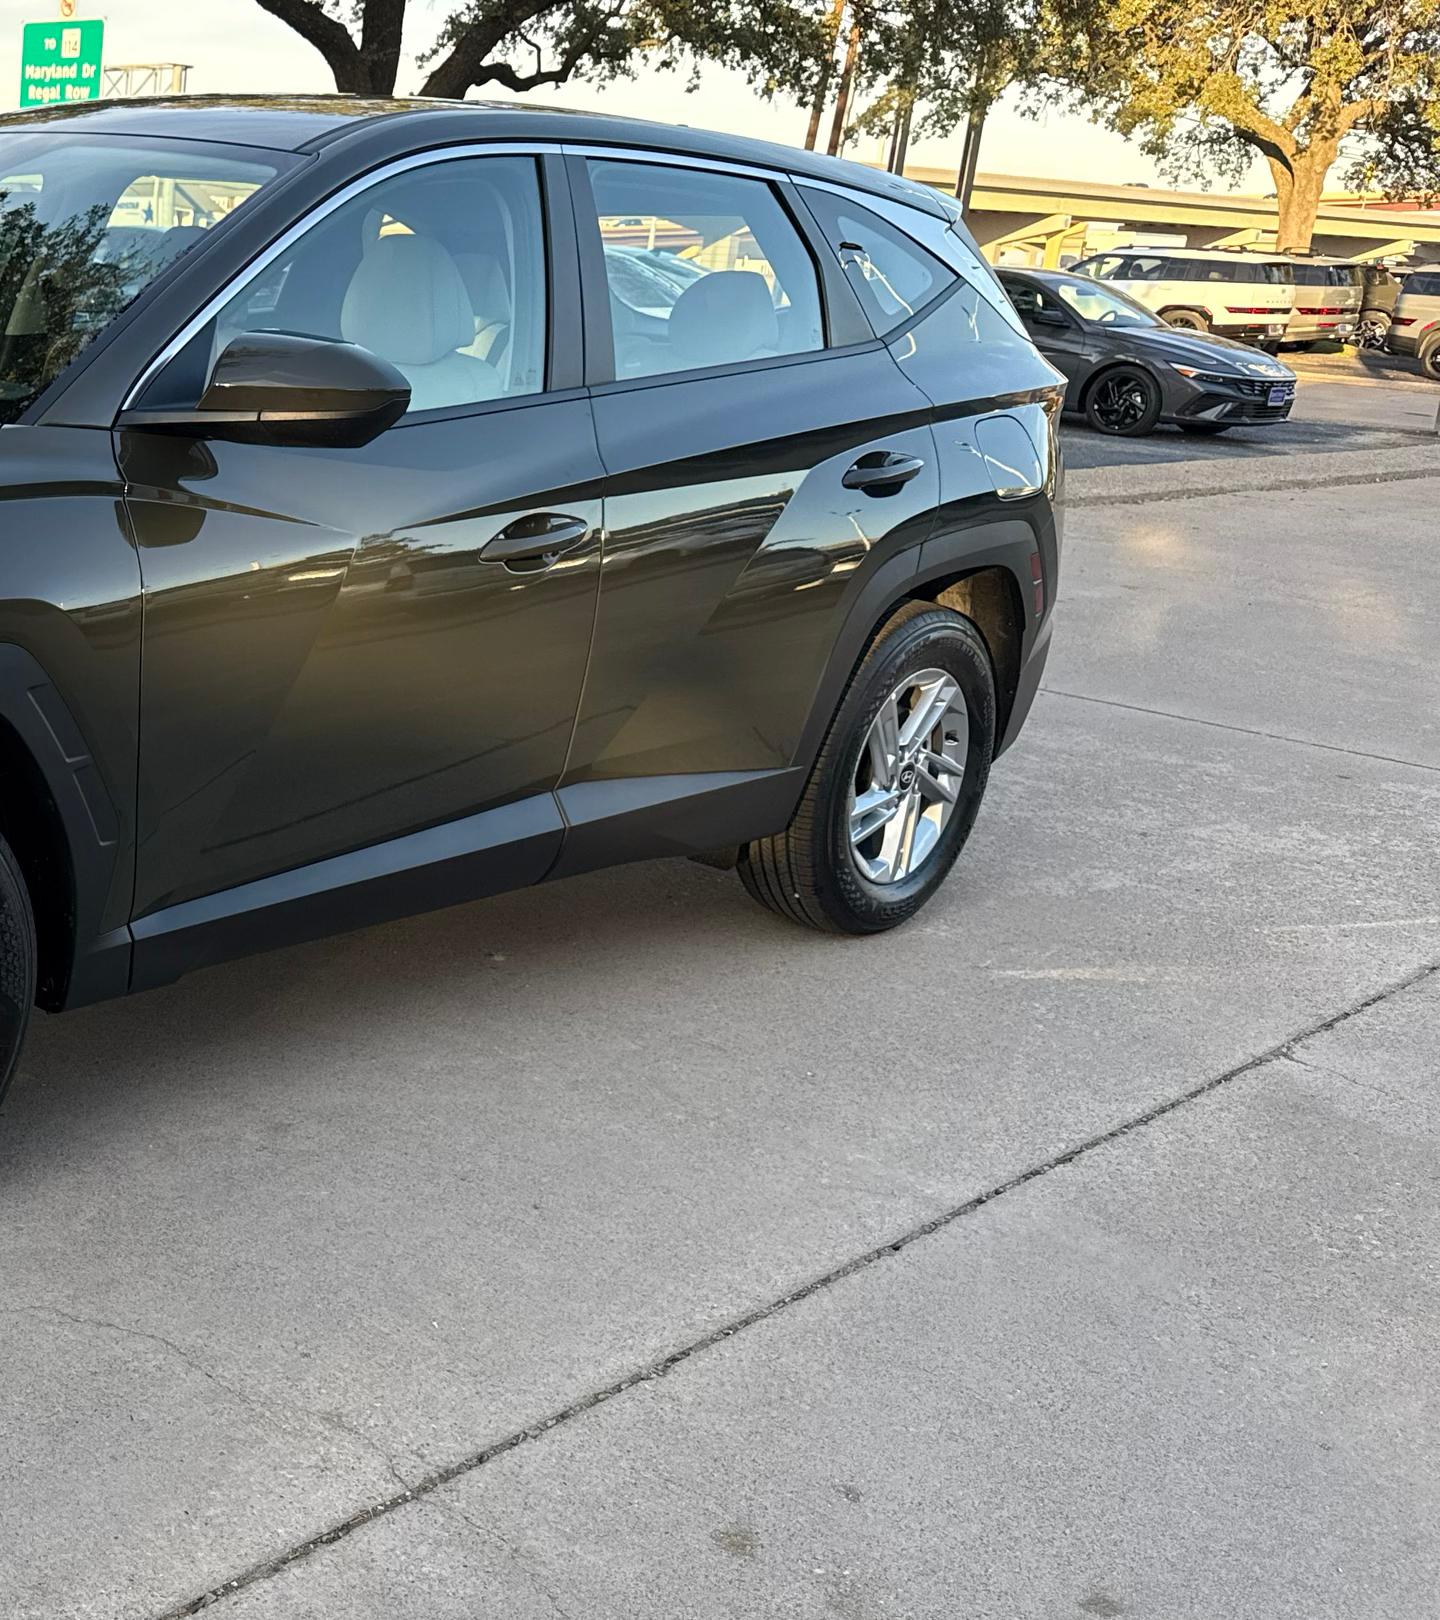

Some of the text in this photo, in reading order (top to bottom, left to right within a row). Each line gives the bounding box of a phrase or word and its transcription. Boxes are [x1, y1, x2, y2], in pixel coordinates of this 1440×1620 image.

[43, 38, 78, 54] TO 114
[24, 62, 97, 82] Maryland Dr
[27, 83, 91, 104] Regal Row
